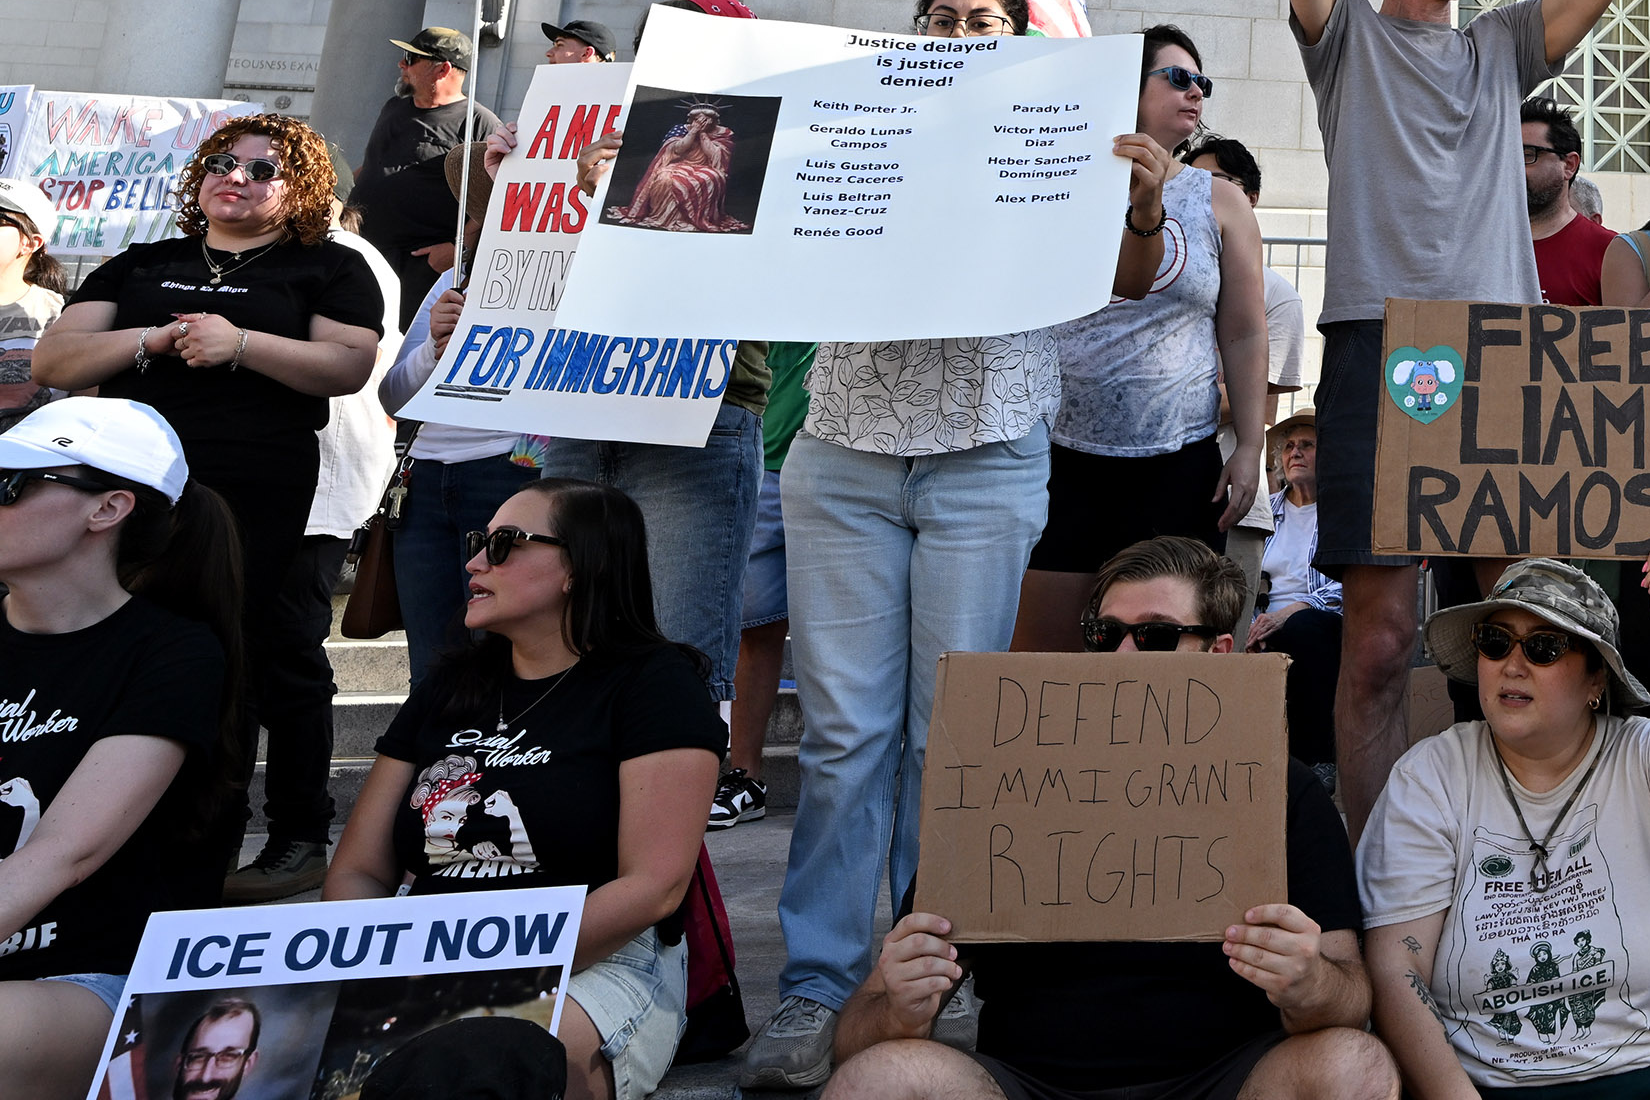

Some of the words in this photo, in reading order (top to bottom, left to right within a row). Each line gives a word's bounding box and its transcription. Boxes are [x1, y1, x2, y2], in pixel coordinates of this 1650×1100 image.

[848, 34, 917, 51] Justice
[924, 39, 998, 54] delayed
[876, 55, 893, 68] is
[897, 56, 965, 71] justice
[880, 75, 954, 88] denied!
[813, 100, 849, 112] Keith
[854, 103, 897, 114] Porter
[900, 105, 917, 115] Jr.
[1012, 104, 1061, 115] Parady
[1065, 102, 1080, 112] La
[47, 100, 163, 148] WAKE
[809, 124, 866, 137] Geraldo
[870, 126, 912, 137] Lunas
[993, 124, 1035, 135] Victor
[1039, 122, 1088, 135] Manuel
[830, 139, 888, 151] Campos
[1025, 138, 1055, 148] Diaz
[30, 150, 174, 176] AMERICA
[805, 158, 837, 170] Luis
[840, 160, 899, 171] Gustavo
[988, 156, 1030, 166] Heber
[1034, 152, 1092, 165] Sanchez
[796, 172, 842, 184] Nunez
[847, 173, 904, 184] Caceres
[38, 177, 105, 211] STOP
[803, 191, 834, 202] Luis
[838, 191, 891, 202] Beltran
[995, 193, 1027, 203] Alex
[1031, 190, 1070, 202] Pretti
[500, 182, 588, 234] WAS
[803, 205, 888, 216] Yanez-Cruz
[51, 214, 108, 248] THE
[793, 225, 841, 237] Renée
[845, 225, 883, 237] Good
[480, 248, 534, 310] BY
[444, 324, 535, 389] FOR
[523, 328, 738, 399] IMMIGRANTS
[1460, 385, 1645, 469] LIAM
[994, 676, 1222, 747] DEFEND
[0, 710, 78, 743] Worker
[445, 729, 527, 750] Social
[474, 746, 552, 768] Worker
[934, 759, 1262, 811] IMMIGRANT
[990, 824, 1228, 913] RIGHTS
[1484, 881, 1524, 894] FREE
[1565, 856, 1592, 877] ALL
[1543, 900, 1560, 912] KEV
[1552, 928, 1566, 937] RA
[166, 932, 271, 981] ICE
[284, 922, 413, 972] OUT
[423, 911, 569, 963] NOW
[1481, 981, 1563, 1010] ABOLISH
[1572, 968, 1611, 990] I.C.E.
[1533, 1055, 1543, 1063] 25
